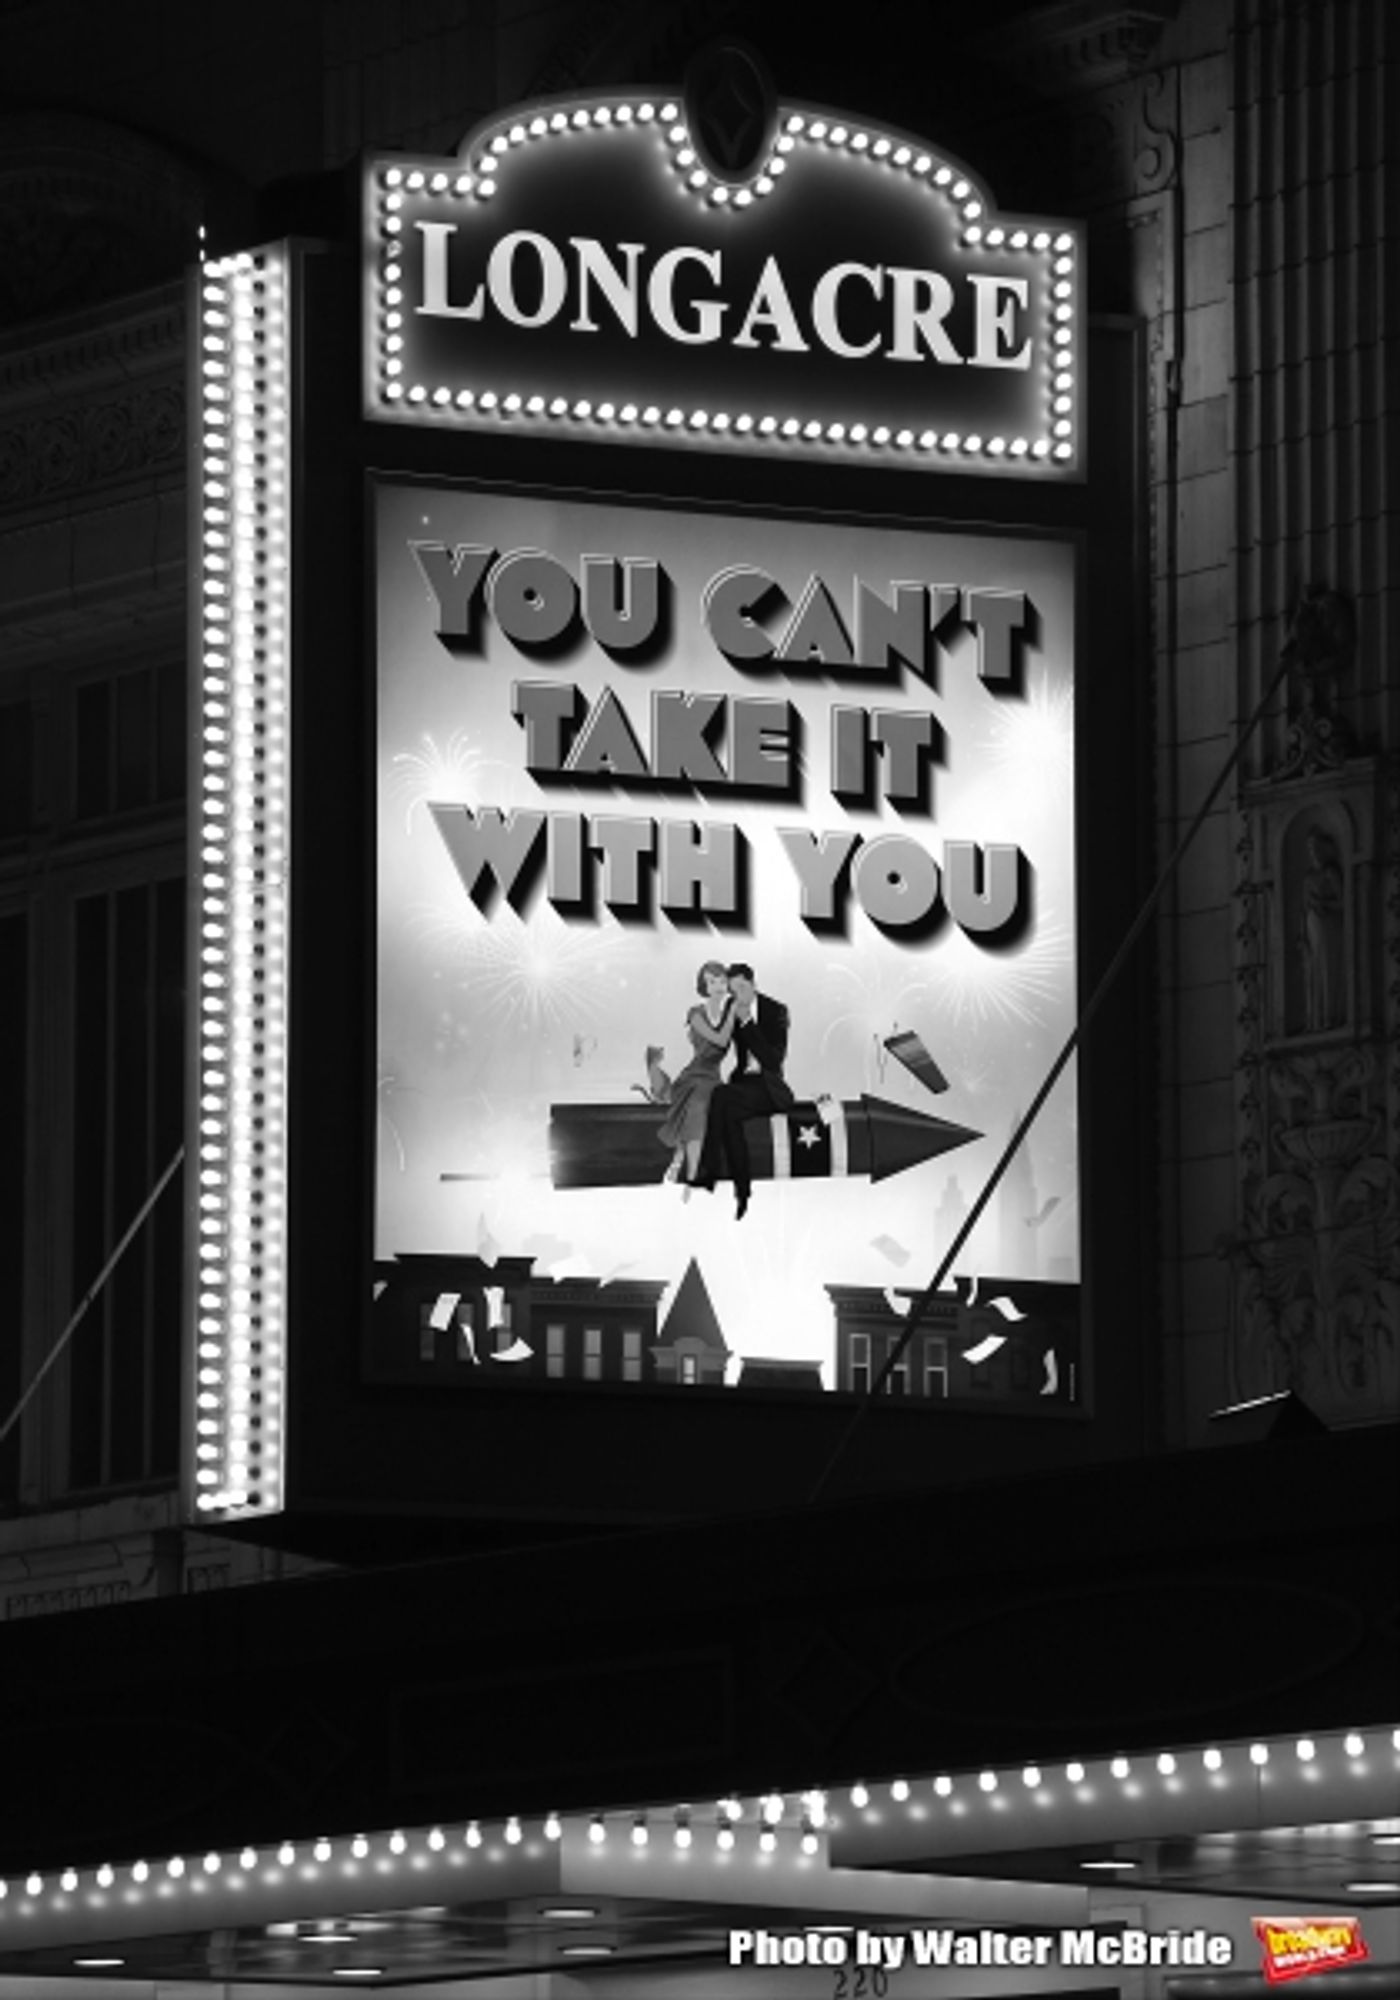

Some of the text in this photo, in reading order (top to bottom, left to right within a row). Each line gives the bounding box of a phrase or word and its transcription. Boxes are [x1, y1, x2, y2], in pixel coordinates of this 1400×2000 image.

[414, 221, 1034, 370] LONGACRE
[408, 541, 1041, 700] YOU CAN'T
[511, 681, 947, 820] TAKE IT
[428, 802, 1037, 953] WITH YOU
[833, 1966, 888, 2000] 220
